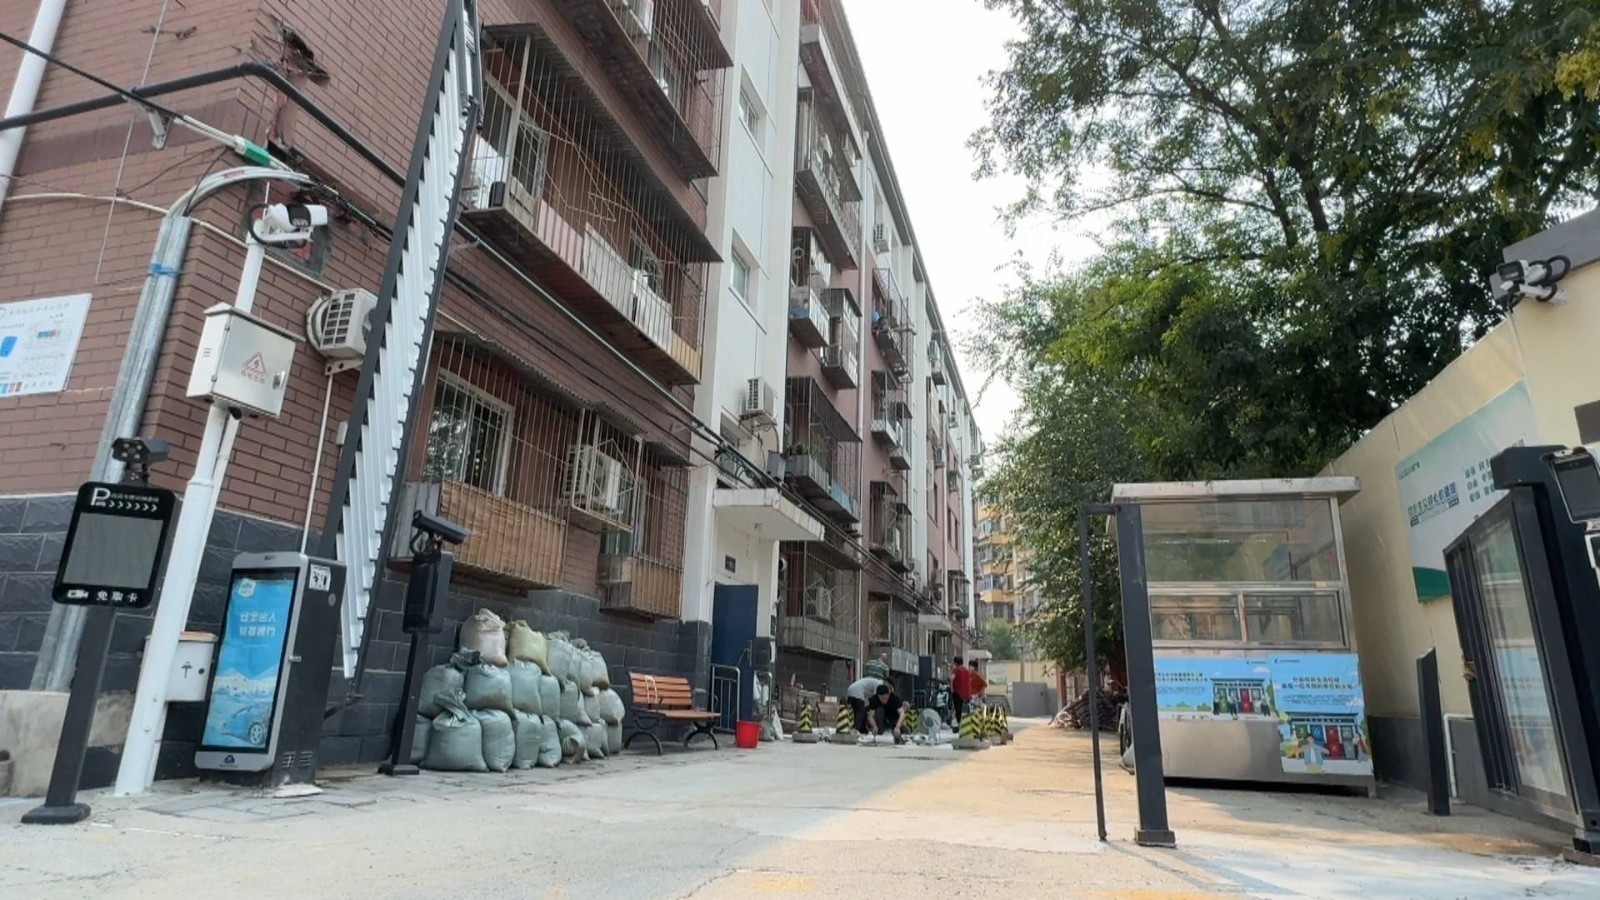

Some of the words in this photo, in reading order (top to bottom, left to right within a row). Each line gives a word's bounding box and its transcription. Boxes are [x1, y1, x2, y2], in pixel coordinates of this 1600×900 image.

[90, 487, 111, 506] P
[96, 589, 138, 602] 免取卡
